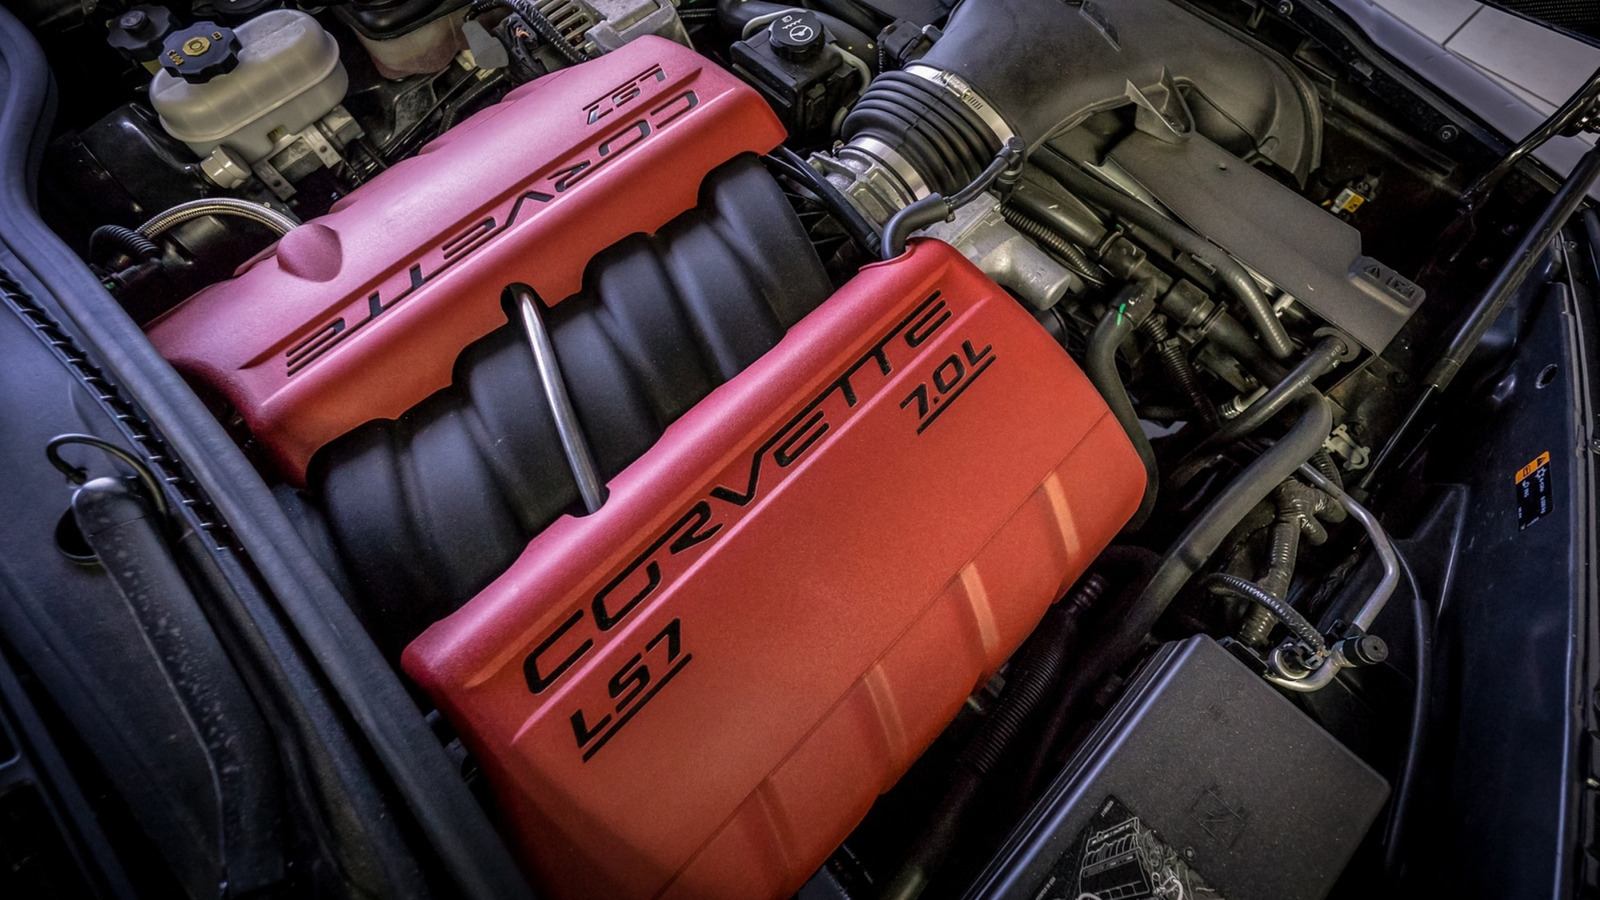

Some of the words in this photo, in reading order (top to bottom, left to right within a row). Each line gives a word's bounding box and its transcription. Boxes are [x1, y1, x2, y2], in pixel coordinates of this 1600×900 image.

[583, 64, 666, 125] LS7
[286, 89, 699, 377] CORVETTE
[900, 339, 994, 424] 7.0L
[522, 289, 952, 695] CORVETTE
[569, 616, 684, 750] LS7
